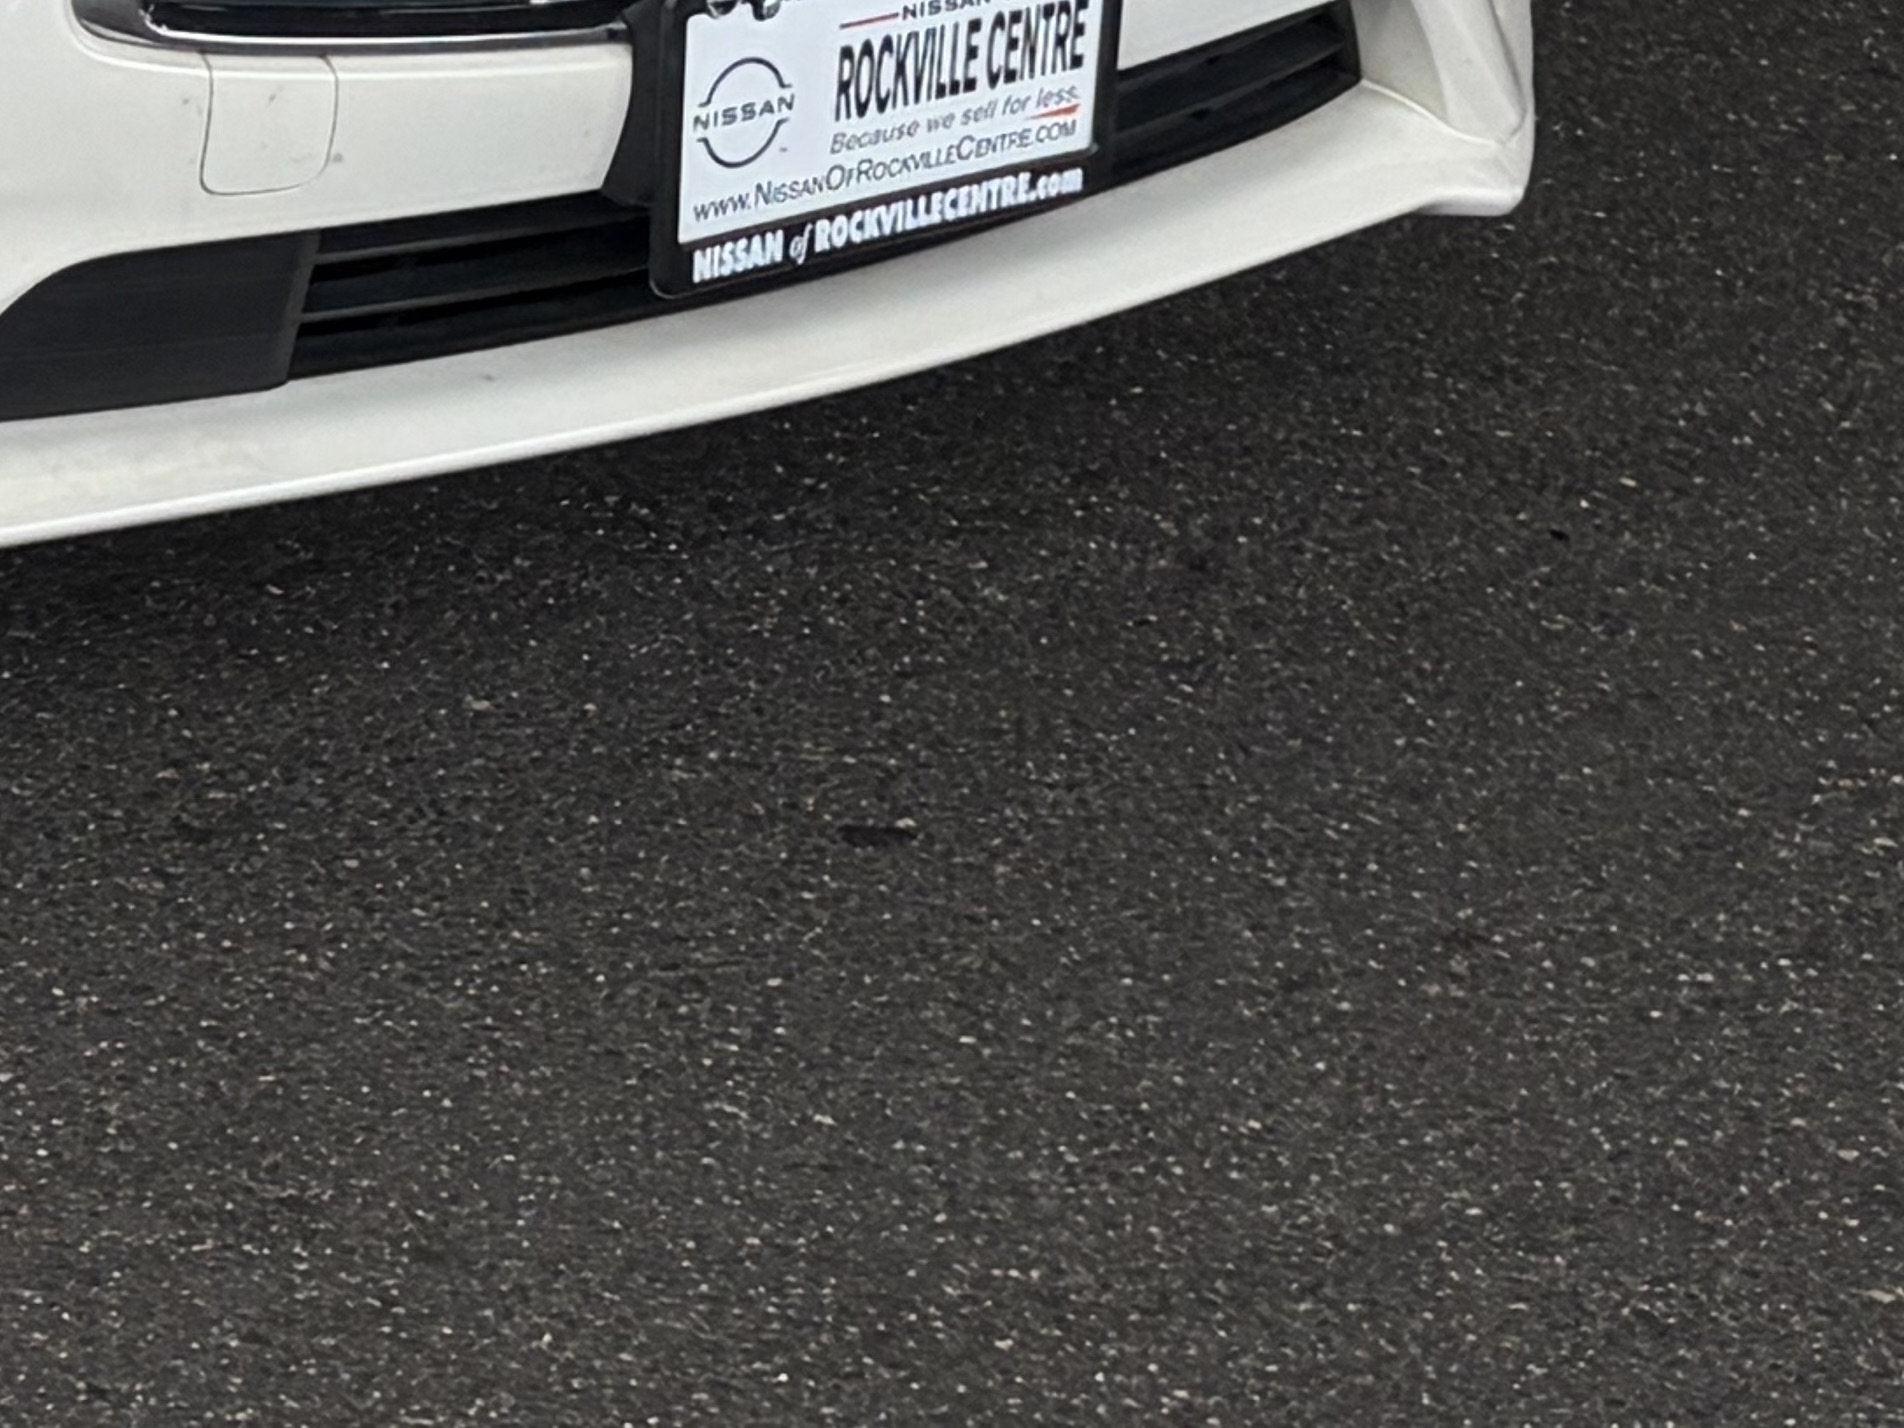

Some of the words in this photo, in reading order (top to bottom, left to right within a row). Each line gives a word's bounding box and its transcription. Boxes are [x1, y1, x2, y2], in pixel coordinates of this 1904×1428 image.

[834, 18, 979, 123] ROCKVILLE
[692, 93, 795, 132] NISSAN
[829, 117, 921, 155] Because
[925, 114, 954, 133] we
[960, 99, 999, 126] sell
[1001, 94, 1032, 117] for
[692, 229, 785, 284] NISSAN
[788, 222, 813, 265] of
[813, 167, 1085, 254] ROCKVILLECENTRE.com
